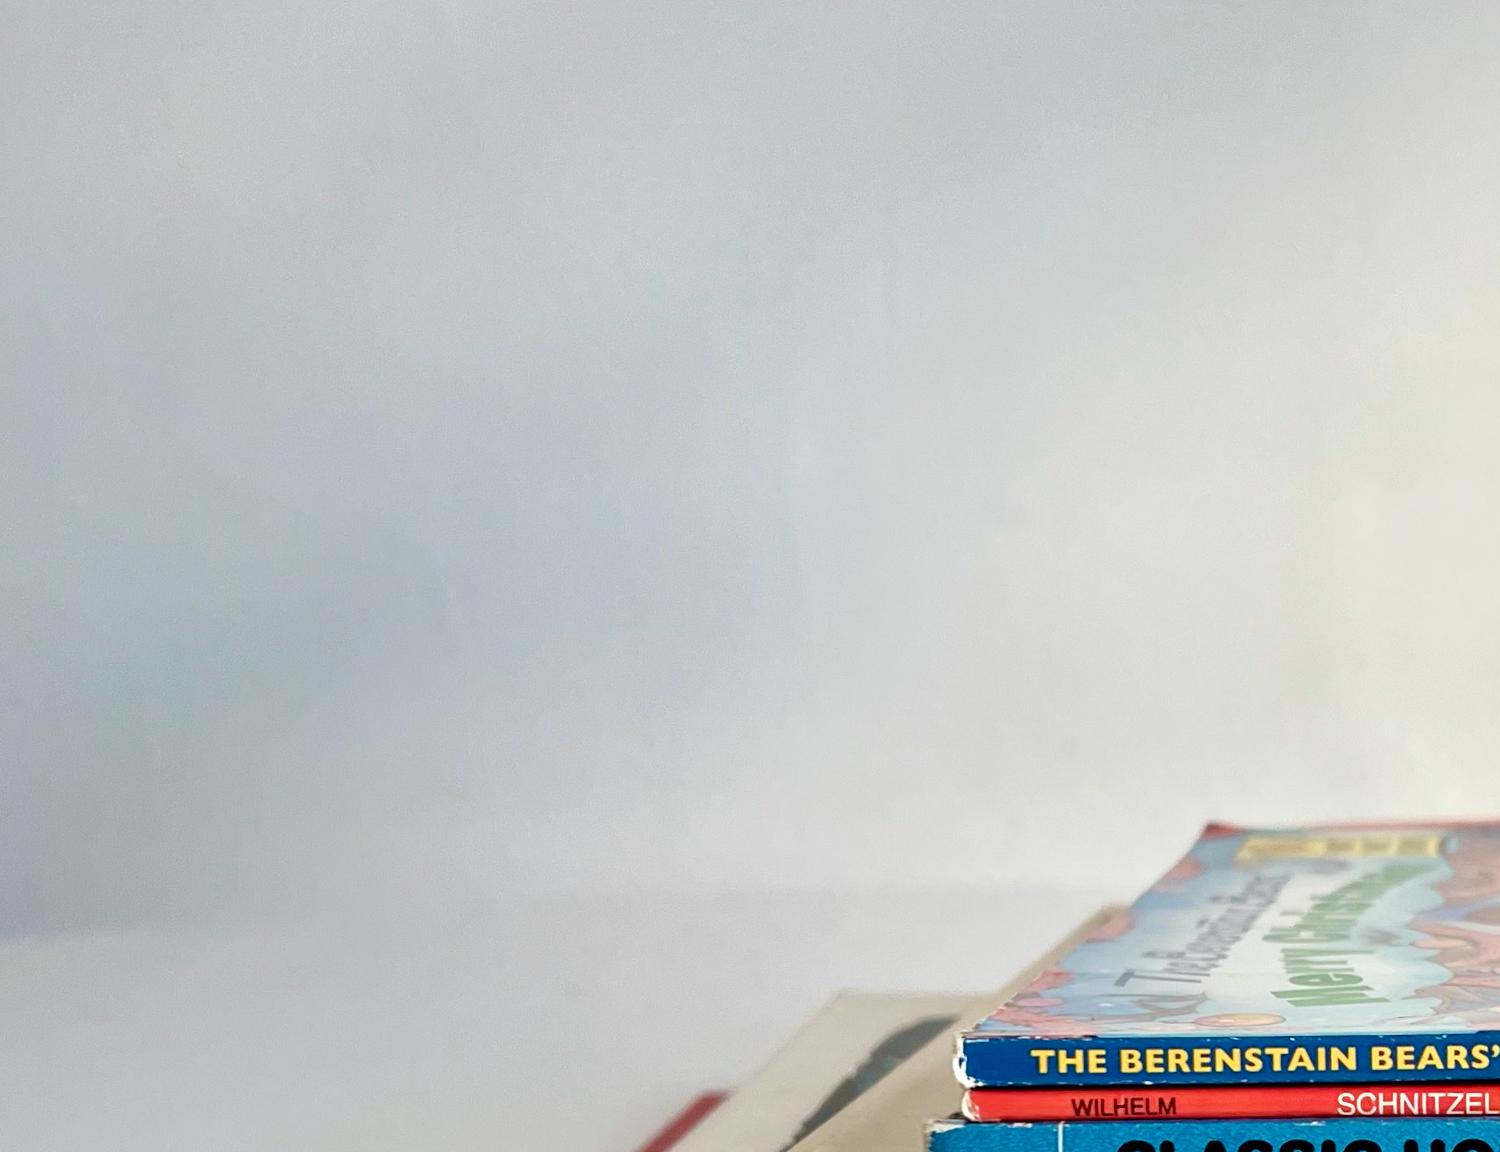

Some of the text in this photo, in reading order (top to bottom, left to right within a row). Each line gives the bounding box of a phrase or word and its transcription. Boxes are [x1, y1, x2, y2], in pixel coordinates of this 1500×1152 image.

[1031, 1048, 1107, 1075] THE
[1120, 1046, 1358, 1074] BERENSTAIN
[1071, 1097, 1177, 1118] WILHELM
